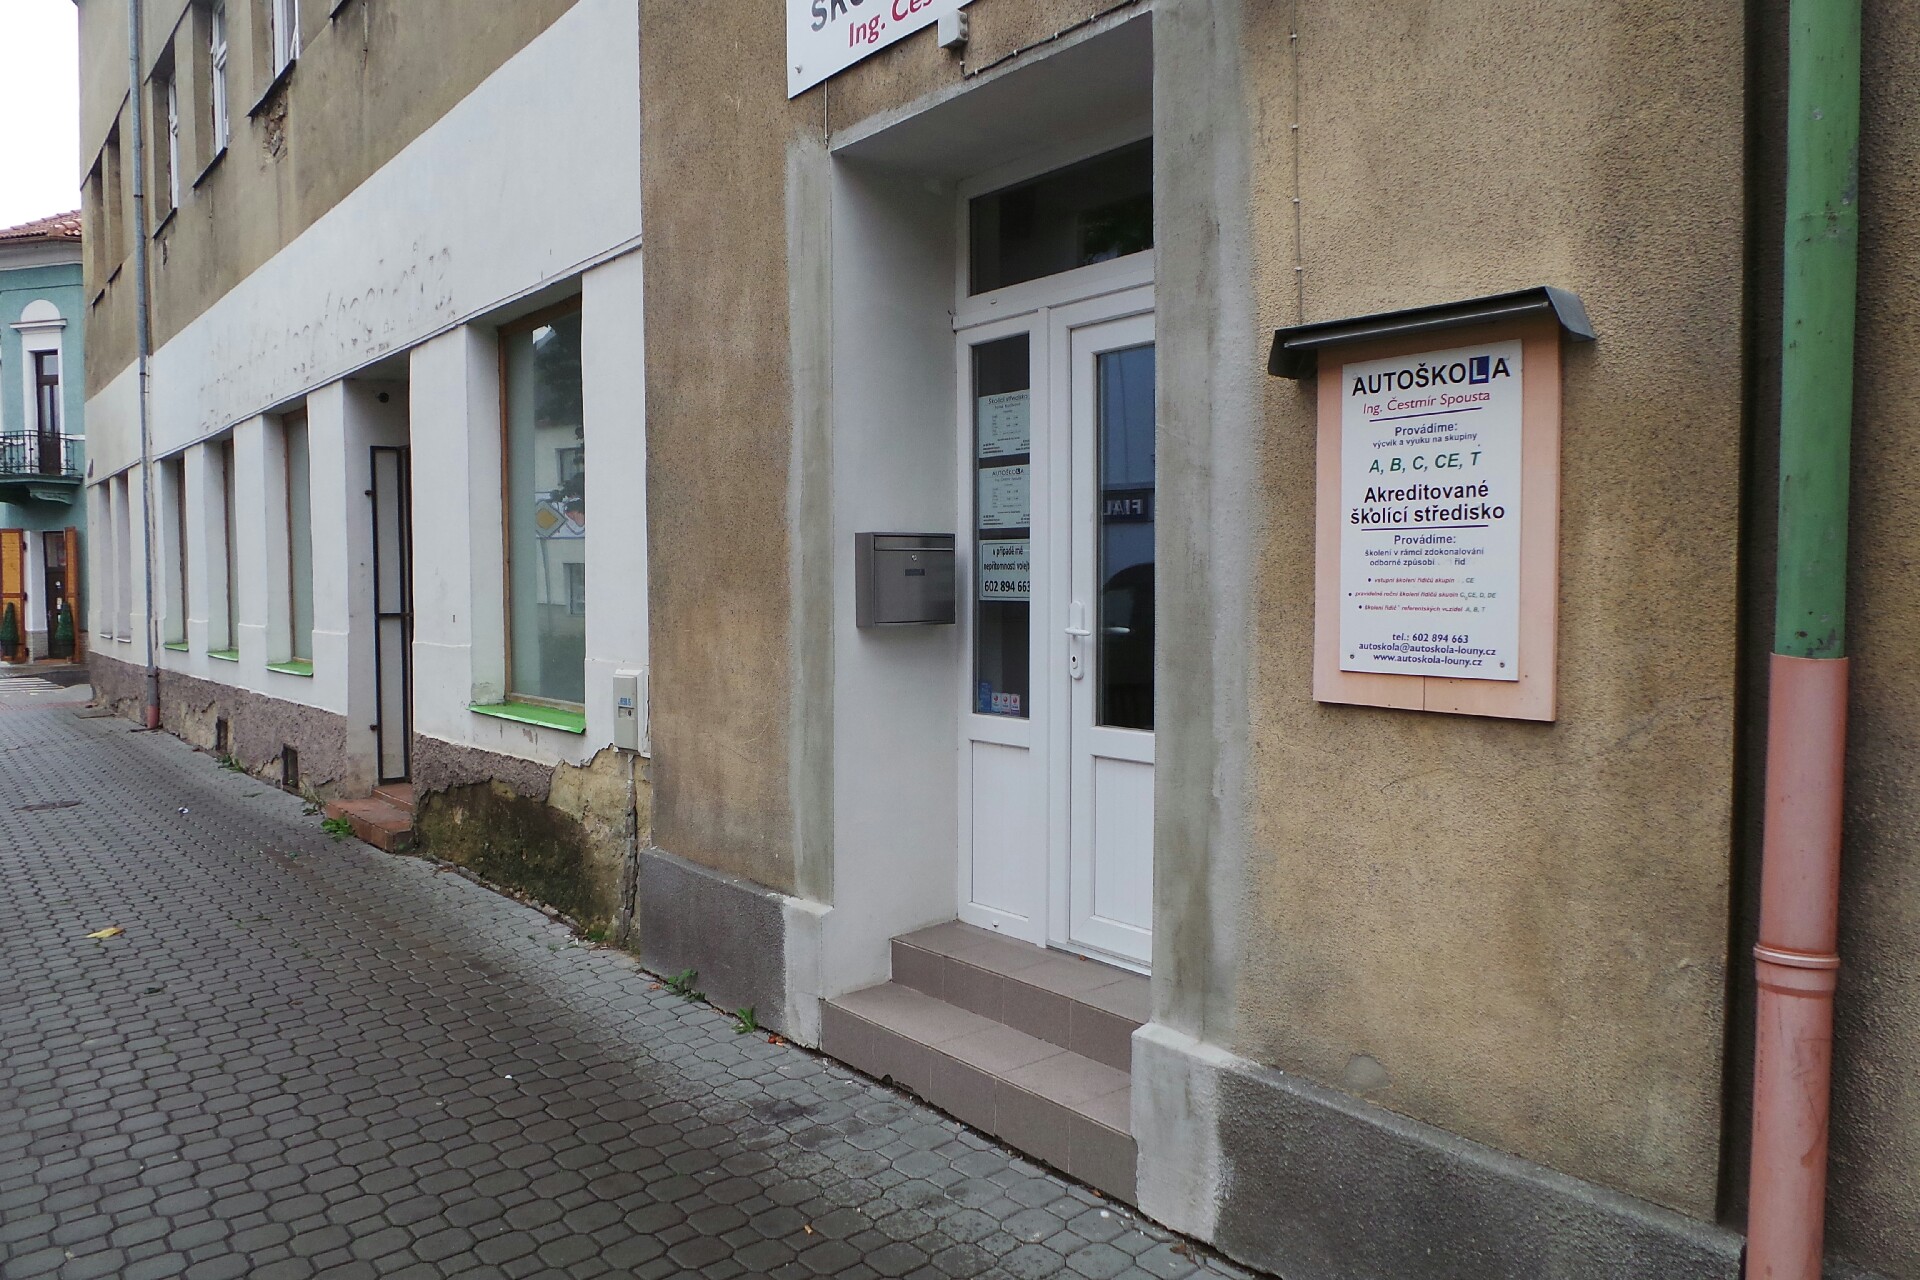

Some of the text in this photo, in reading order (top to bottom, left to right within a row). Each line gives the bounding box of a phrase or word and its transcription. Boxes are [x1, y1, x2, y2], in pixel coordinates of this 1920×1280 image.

[849, 13, 886, 48] Ing.
[1352, 356, 1511, 396] AUTOŠKOLA
[1363, 390, 1490, 416] Ing. Čestmír Spousta
[1395, 422, 1458, 437] Provádíme:
[1373, 440, 1397, 449] výcvik
[1399, 438, 1404, 446] a
[1432, 435, 1443, 443] na
[1444, 432, 1478, 444] skupiny
[1368, 451, 1482, 475] A, B, C, CE, T
[1364, 480, 1489, 503] Akreditované
[1350, 503, 1505, 525] školící středisko
[1394, 534, 1456, 545] Provádíme:
[1424, 547, 1485, 556] zdokonalování
[984, 580, 999, 592] 602
[1000, 580, 1016, 592] 894
[1412, 633, 1429, 642] 602
[1431, 634, 1449, 643] 894
[1451, 634, 1469, 644] 663
[1358, 642, 1496, 656] autoskola@autoskola-louny.cz
[1373, 655, 1483, 668] www.autoskola-louny.cz
